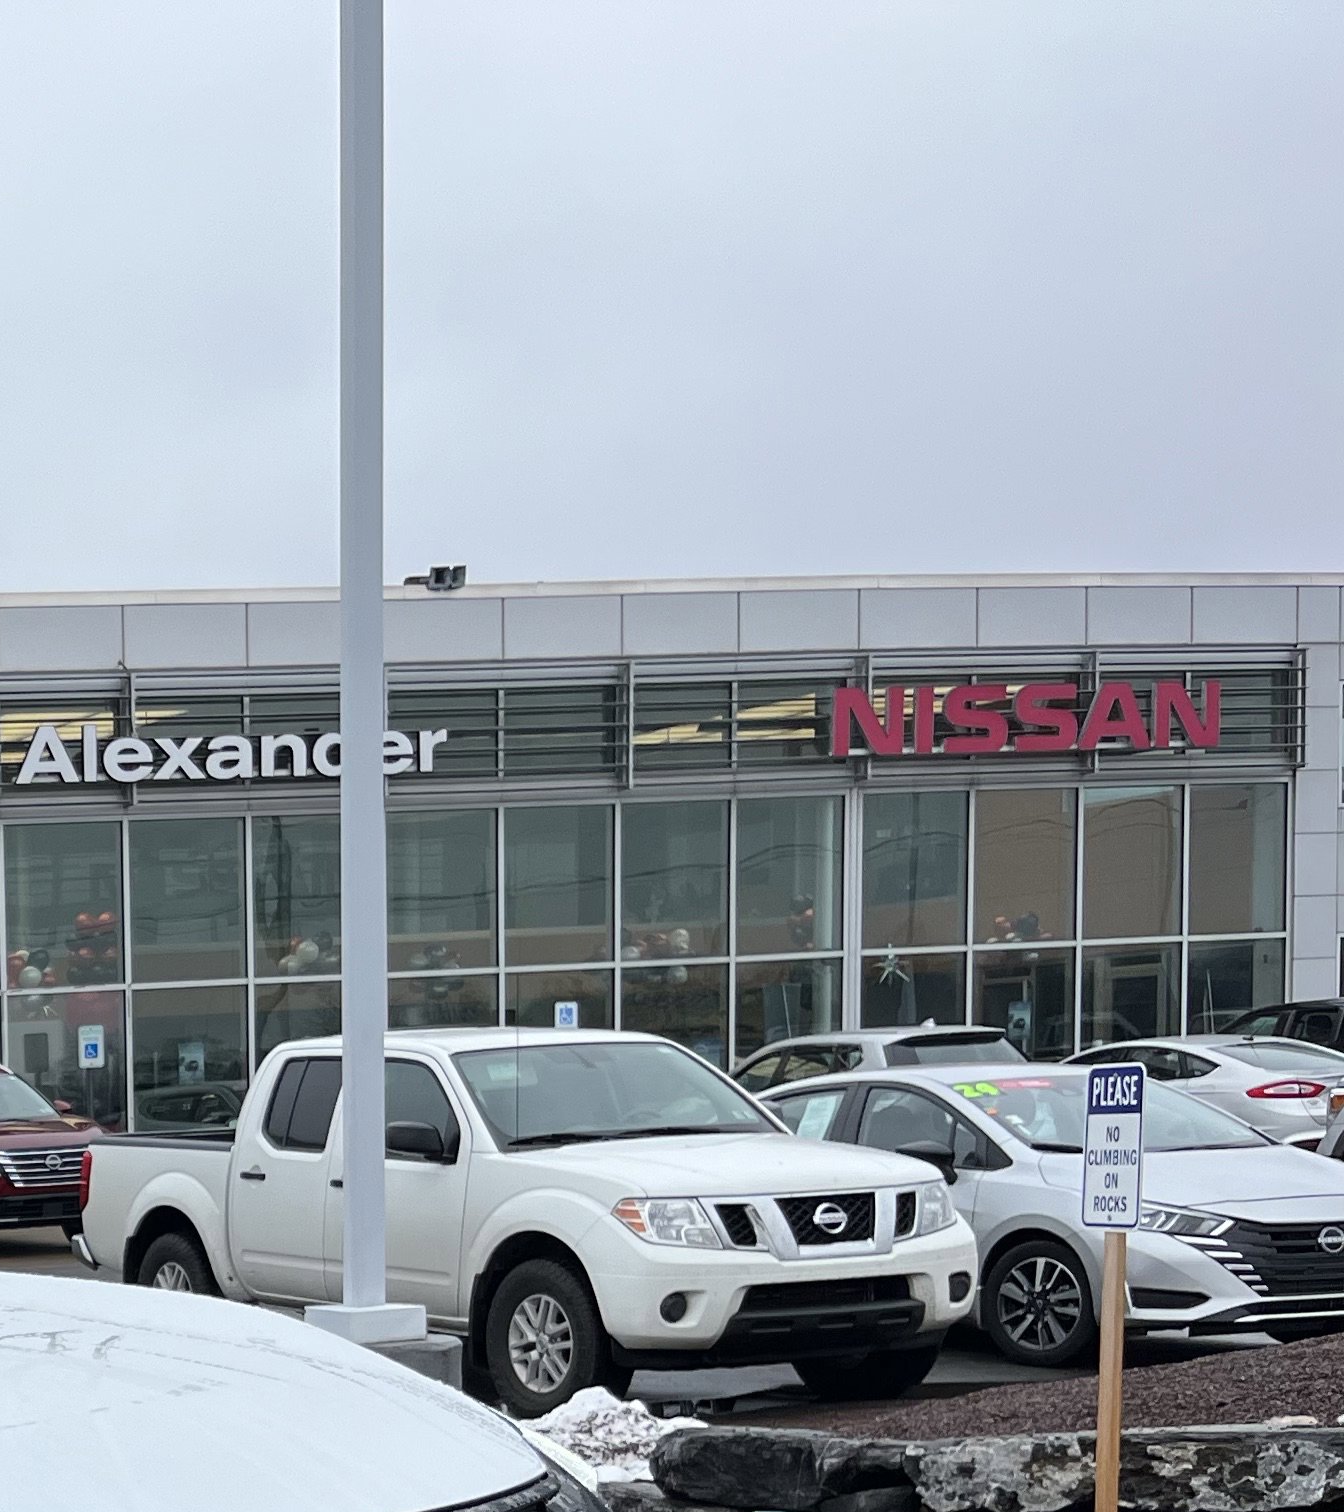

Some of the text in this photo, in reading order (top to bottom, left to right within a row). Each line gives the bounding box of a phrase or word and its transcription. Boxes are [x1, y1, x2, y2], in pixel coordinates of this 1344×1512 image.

[830, 681, 1222, 757] NISSAN
[1092, 1075, 1139, 1107] PLEASE
[1105, 1126, 1120, 1142] NO
[1088, 1149, 1137, 1166] CLIMBING
[1104, 1172, 1118, 1189] ON
[1093, 1195, 1127, 1213] ROCKS
